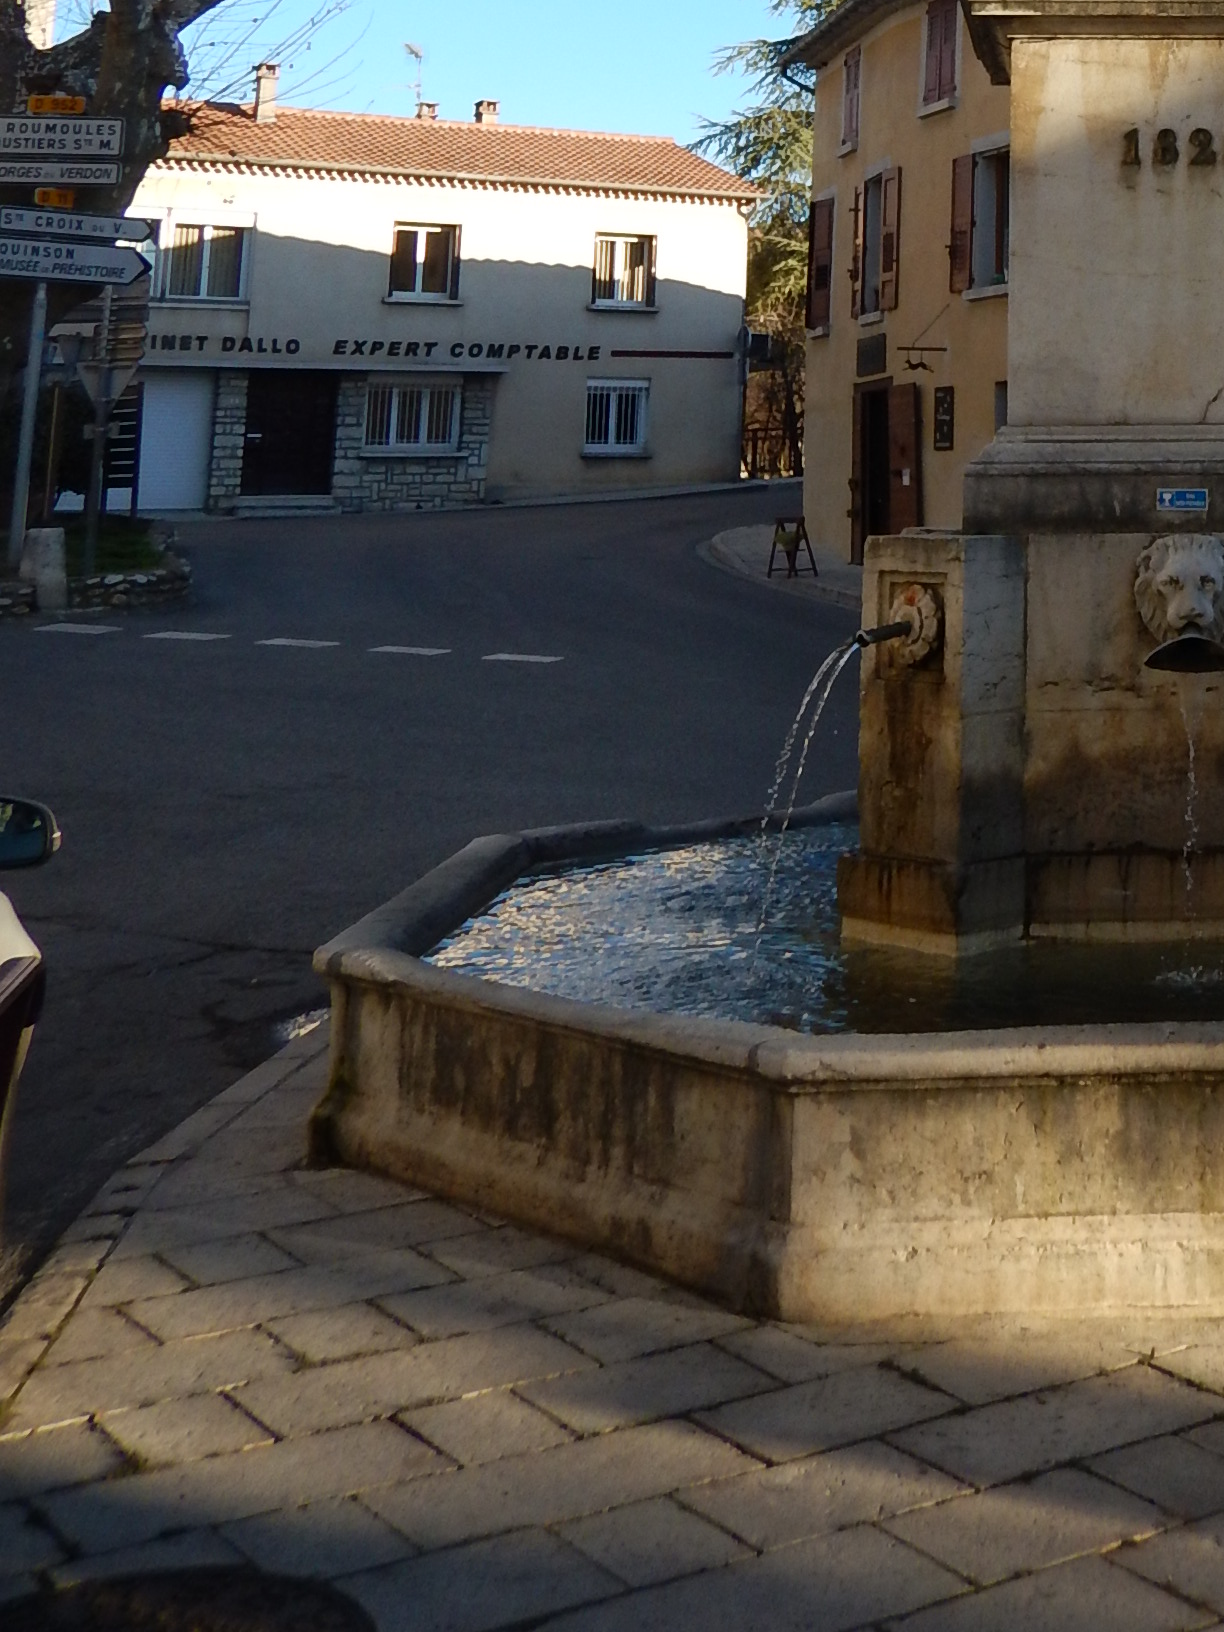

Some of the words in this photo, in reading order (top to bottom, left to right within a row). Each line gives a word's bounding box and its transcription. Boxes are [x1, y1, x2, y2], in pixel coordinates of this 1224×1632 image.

[34, 98, 44, 111] D
[51, 99, 78, 112] 952
[6, 122, 117, 136] ROUMOULES
[0, 137, 67, 150] USTIERS
[0, 166, 43, 179] ORGES
[59, 167, 113, 180] VERDON
[35, 215, 84, 231] CROIX
[51, 262, 127, 280] PRÉHISTOIRE
[150, 334, 208, 351] INET
[221, 336, 301, 355] DALLO
[332, 339, 438, 357] EXPERT
[450, 342, 601, 361] COMPTABLE
